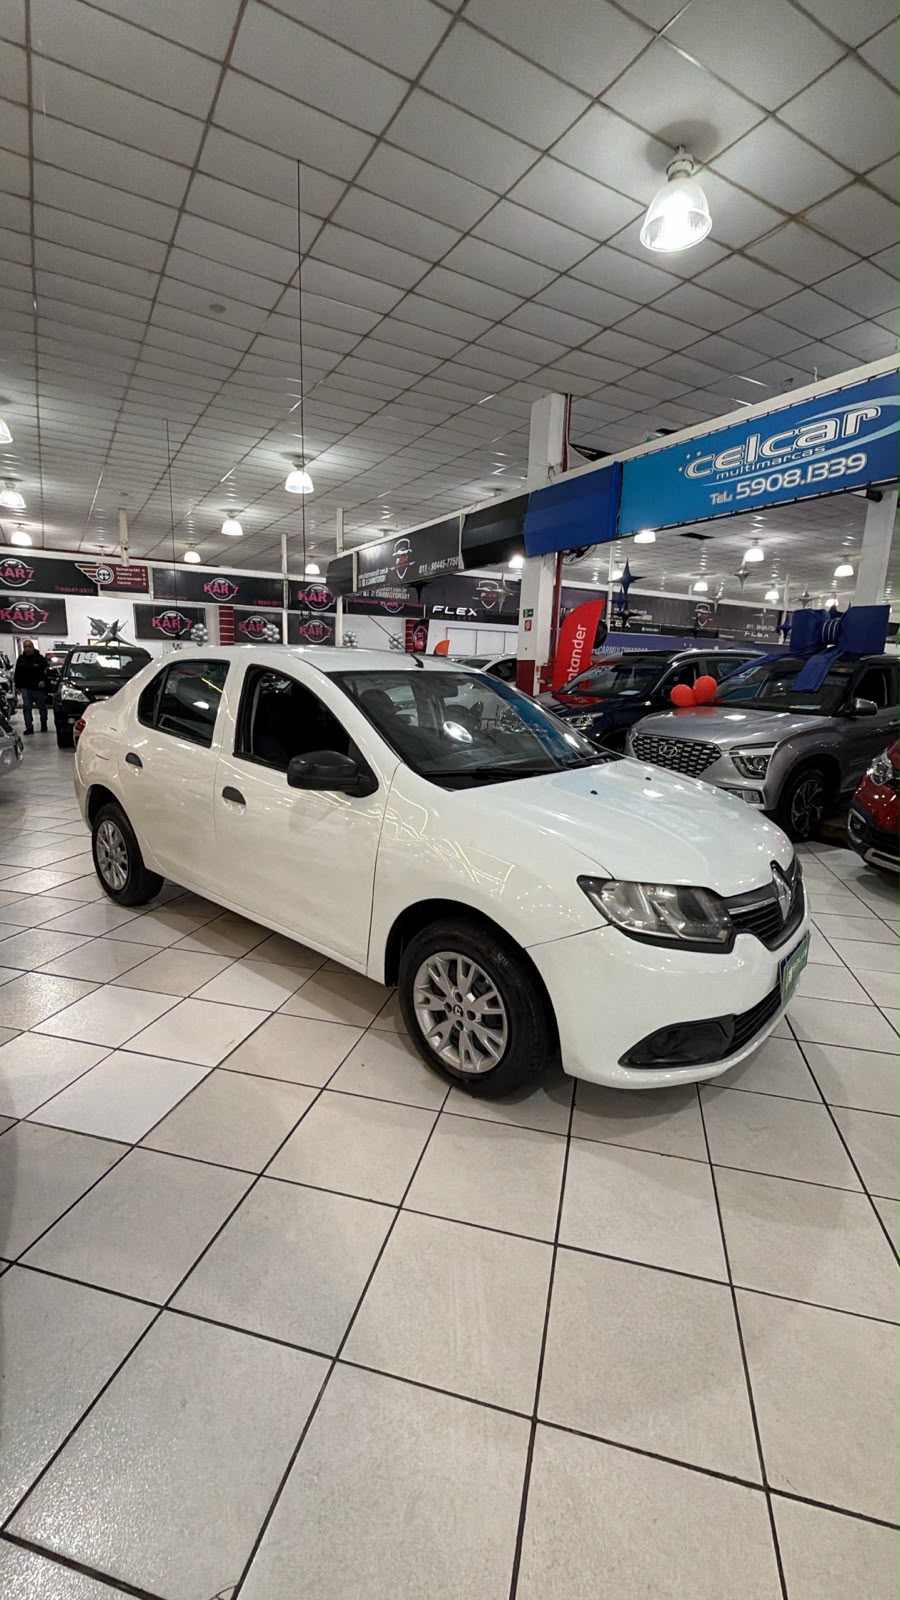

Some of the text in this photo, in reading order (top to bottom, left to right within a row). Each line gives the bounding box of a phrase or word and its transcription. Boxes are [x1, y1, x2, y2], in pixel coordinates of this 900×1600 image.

[685, 406, 881, 479] celcar
[716, 445, 826, 480] multimarcas
[735, 451, 868, 499] 5908.1339
[203, 583, 239, 595] KAR 7
[298, 590, 328, 603] KAR
[0, 609, 49, 624] KAR 7
[432, 605, 479, 617] FLEX
[151, 616, 193, 630] KAR 7
[299, 625, 333, 637] KAR 7
